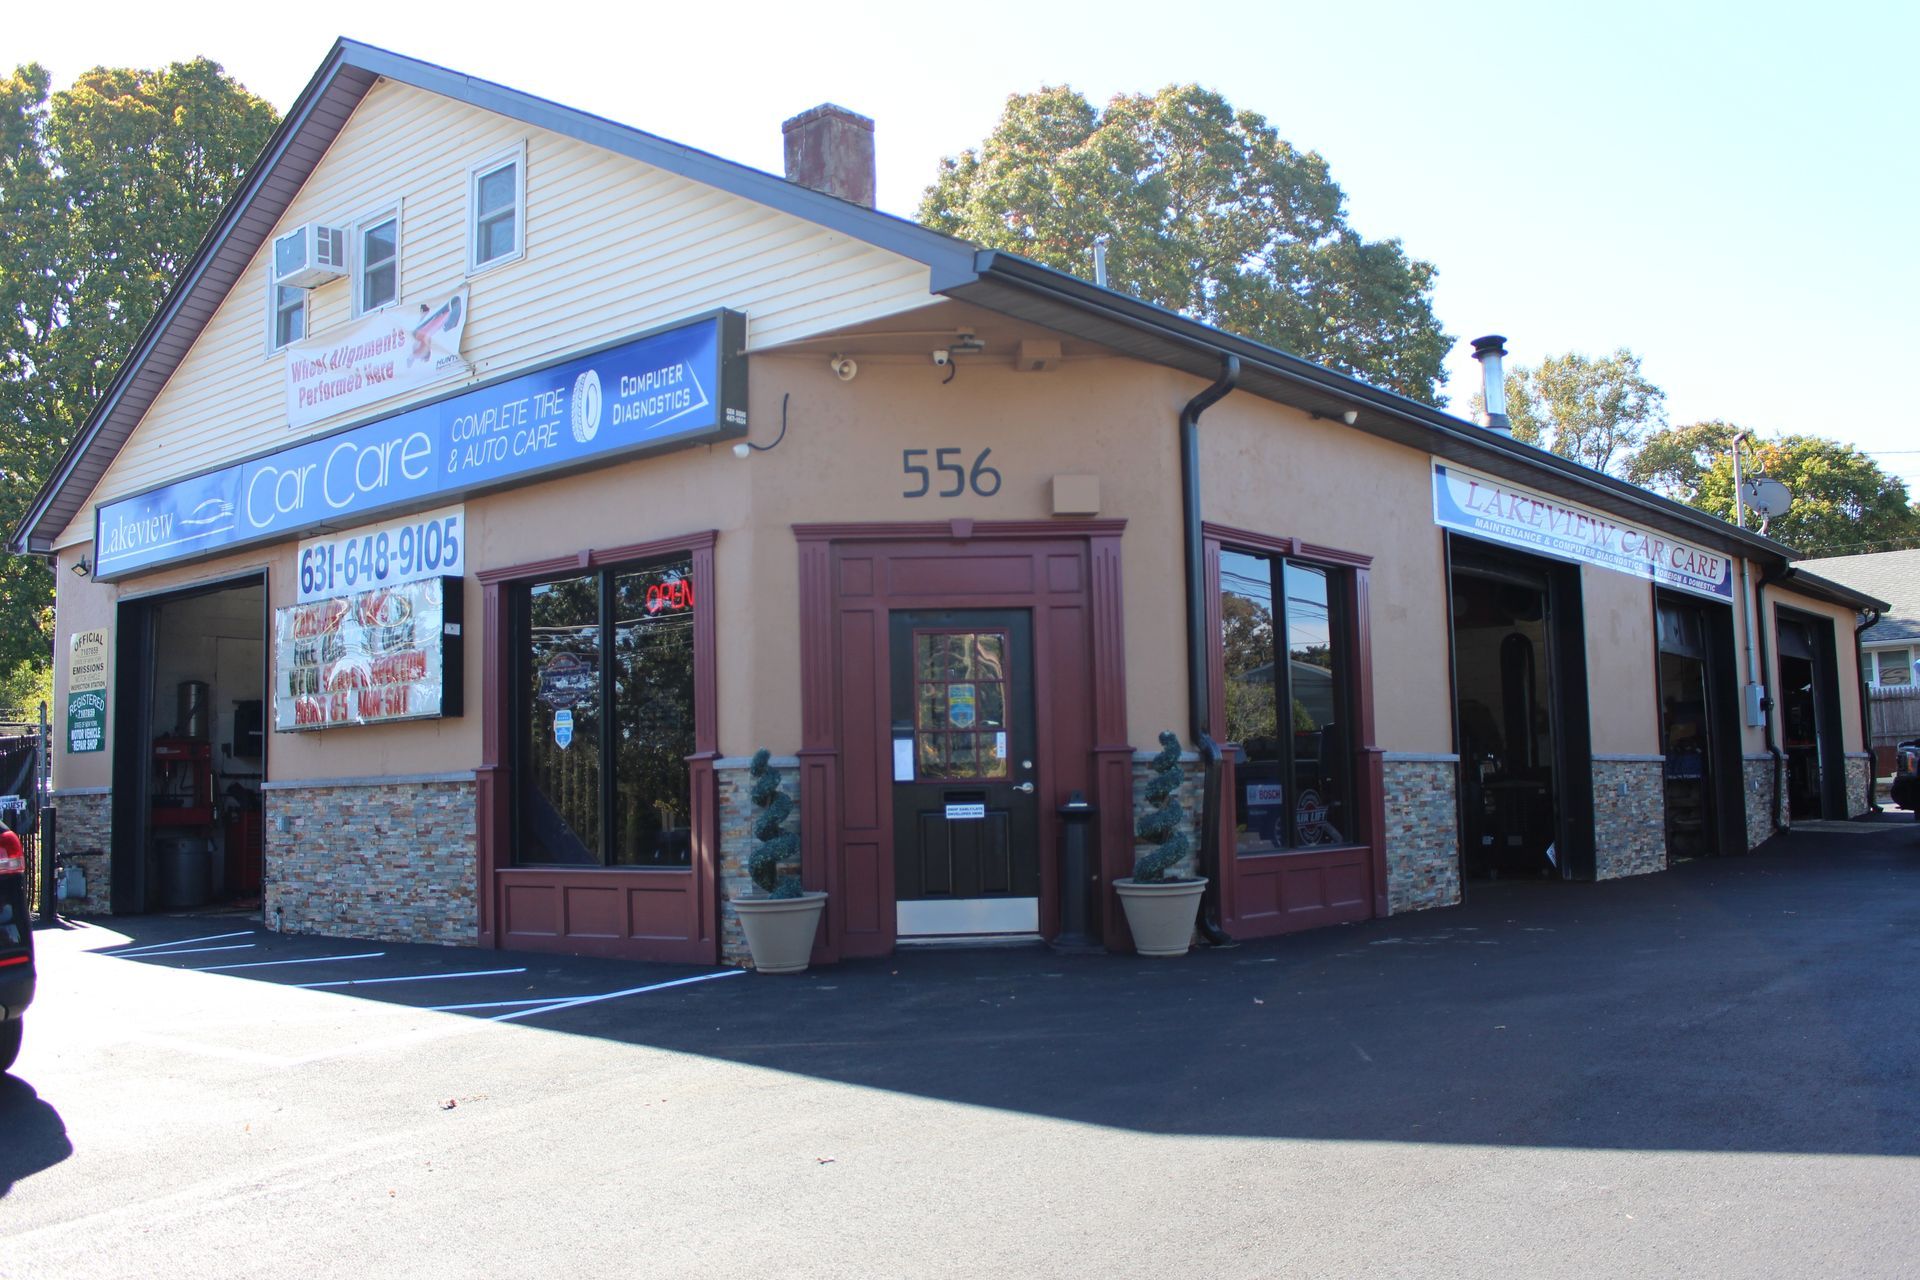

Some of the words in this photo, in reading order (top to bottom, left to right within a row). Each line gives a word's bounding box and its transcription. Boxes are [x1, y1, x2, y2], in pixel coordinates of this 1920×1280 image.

[291, 353, 327, 384] Wheel
[329, 328, 406, 370] Alignments
[298, 368, 362, 408] Performed
[364, 360, 394, 386] Here
[620, 363, 683, 398] COMPUTER
[452, 398, 530, 442] COMPLETE
[533, 387, 565, 420] TIRE
[612, 387, 690, 426] DIAGNOSTICS
[448, 448, 458, 473] &
[462, 435, 508, 470] AUTO
[513, 421, 561, 456] CARE
[247, 463, 317, 528] Car
[323, 432, 432, 509] Care
[903, 447, 1002, 498] 556
[100, 507, 174, 554] Lakeview
[1464, 481, 1616, 547] LAKEVIEW
[1621, 530, 1664, 566] CAR
[1671, 547, 1718, 580] CARE
[1474, 517, 1541, 543] MAINTENANCE
[1543, 537, 1551, 546] &
[1552, 539, 1595, 558] COMPUTER
[1596, 550, 1643, 571] DIAGNOSTICS
[301, 517, 459, 594] 631-648-9105
[646, 579, 694, 612] OPEN
[1656, 568, 1682, 583] FOREIGN
[1682, 575, 1688, 584] &
[1688, 578, 1716, 592] DOMESTIC
[74, 632, 103, 651] OFFICIAL
[73, 662, 104, 675] EMISSIONS
[70, 694, 104, 716] REGISTERED
[71, 729, 84, 740] MOTOR
[85, 727, 100, 739] VEHICLE
[74, 740, 86, 751] REPAIR
[87, 739, 97, 750] SHOP
